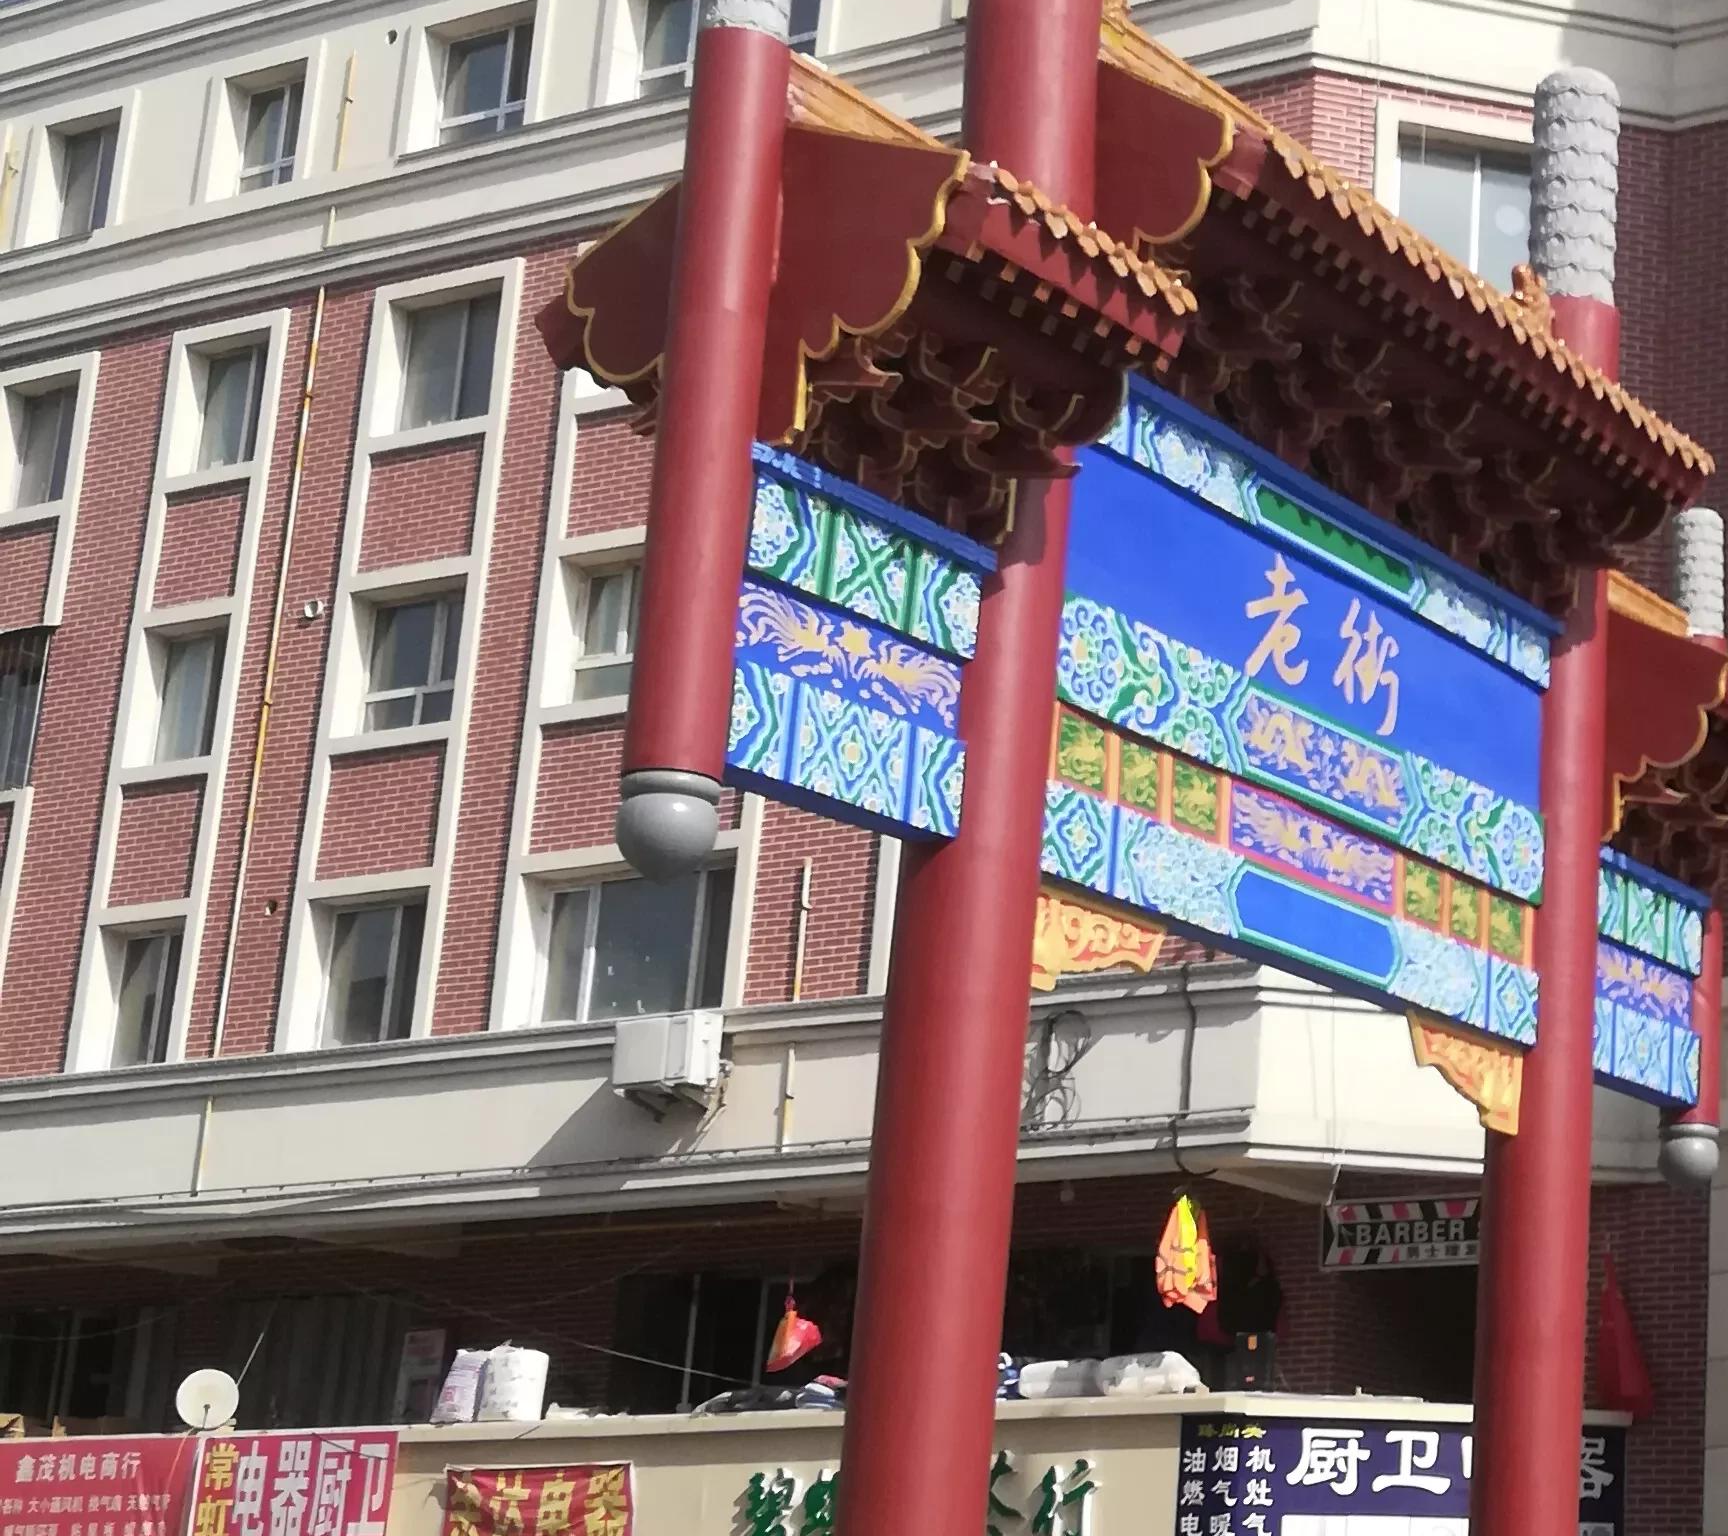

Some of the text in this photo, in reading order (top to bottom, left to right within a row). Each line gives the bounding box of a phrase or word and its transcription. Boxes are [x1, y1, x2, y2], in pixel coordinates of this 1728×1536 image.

[1246, 553, 1400, 735] 老街
[1356, 1219, 1465, 1246] BARBER
[1183, 1444, 1276, 1473] 油烟机
[1180, 1479, 1274, 1507] 燃气灶
